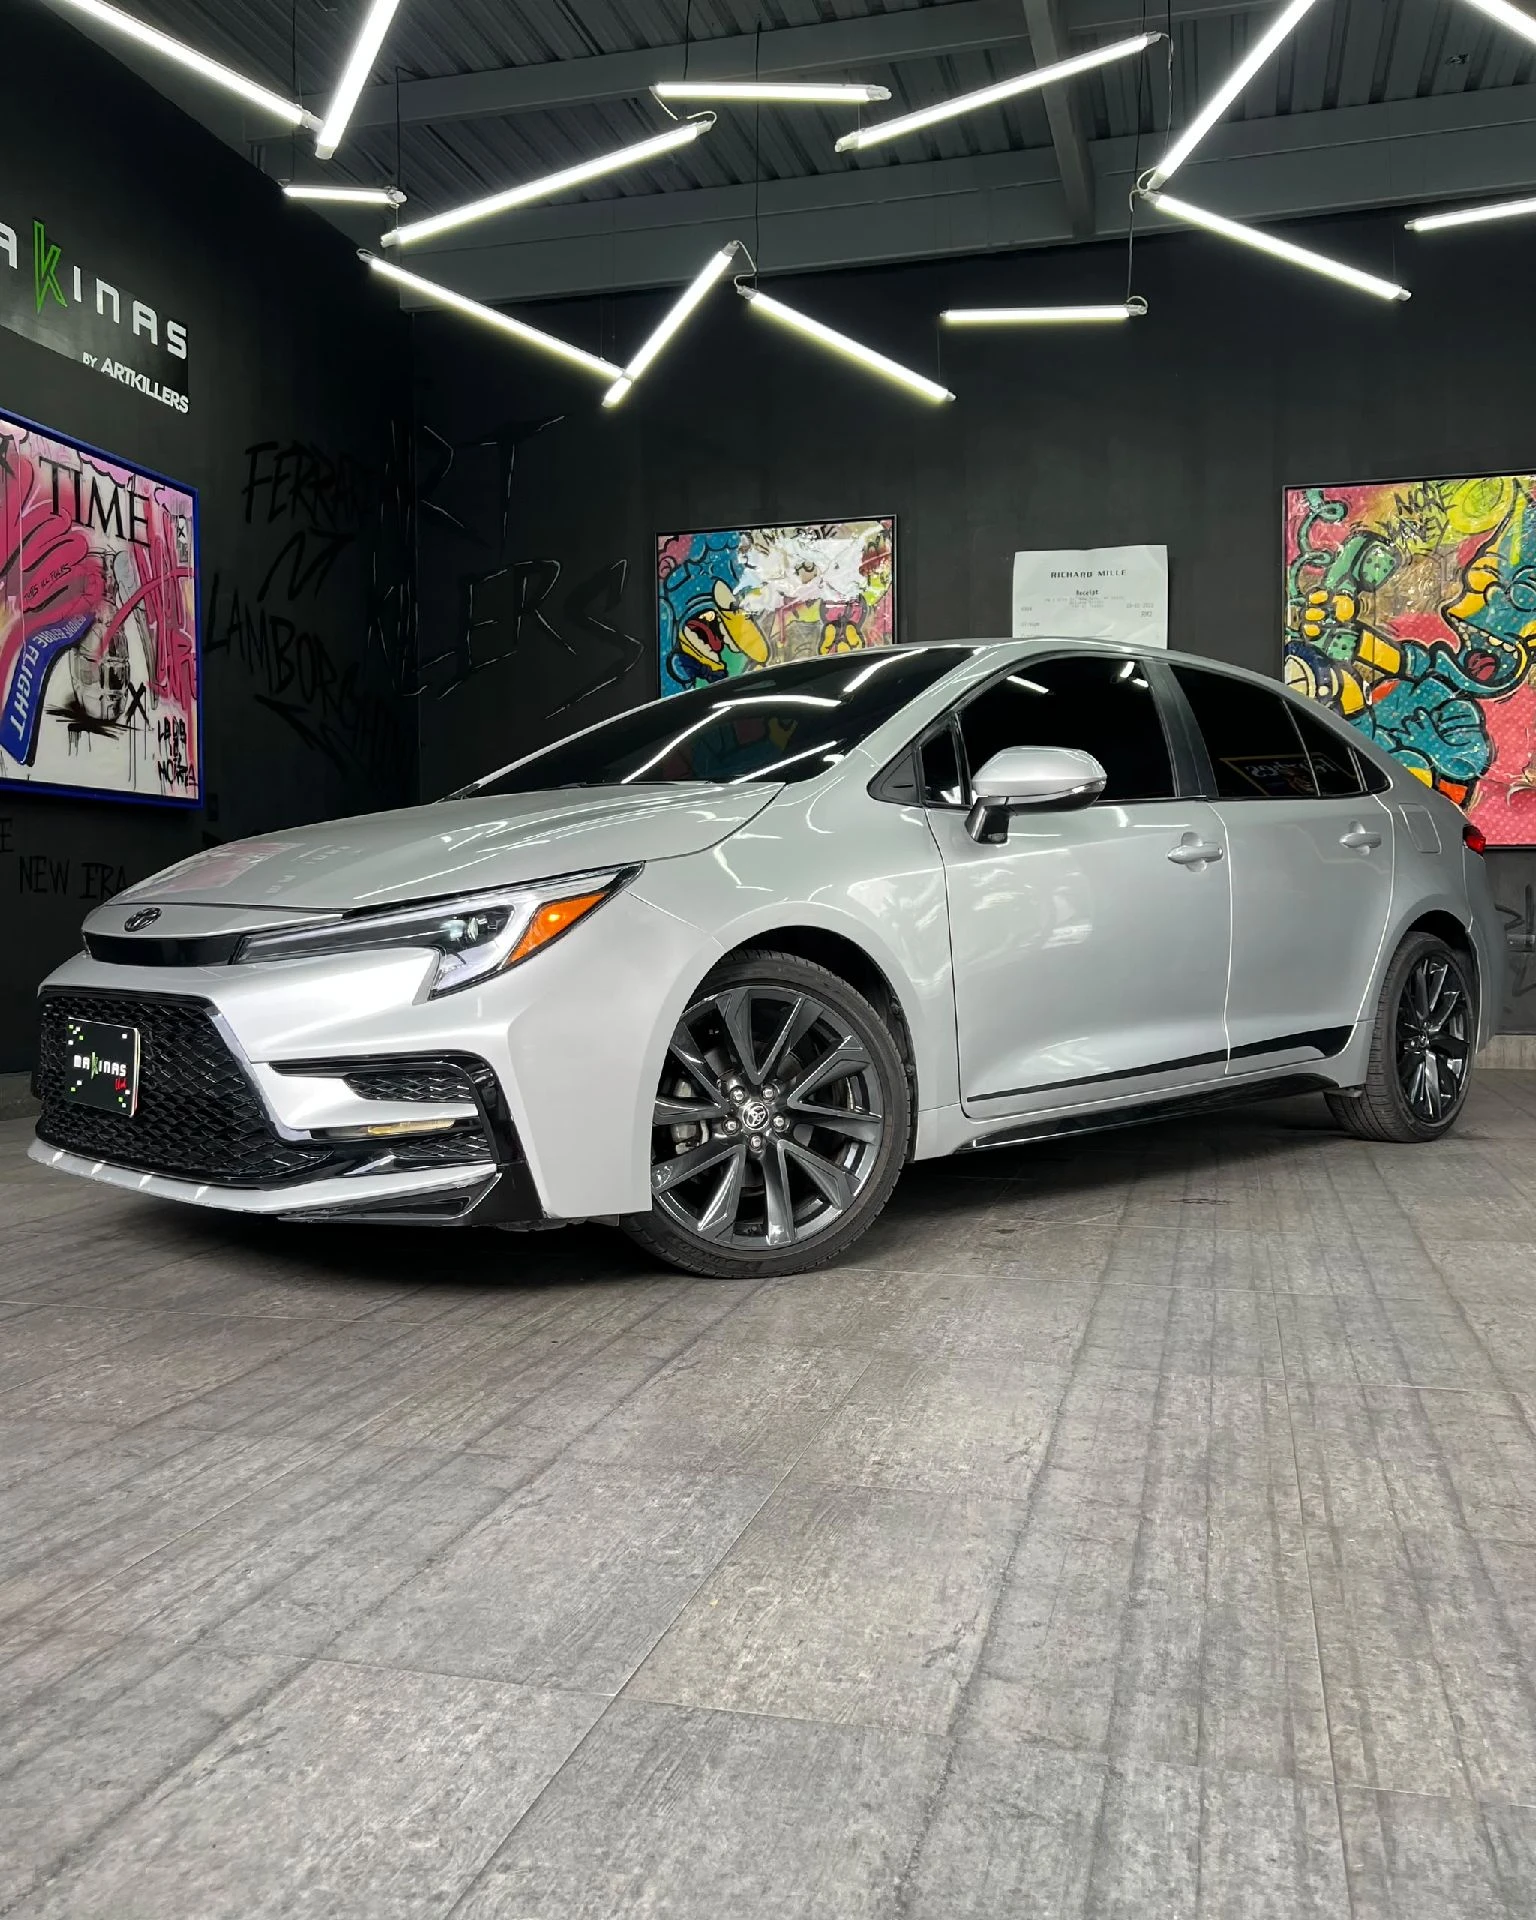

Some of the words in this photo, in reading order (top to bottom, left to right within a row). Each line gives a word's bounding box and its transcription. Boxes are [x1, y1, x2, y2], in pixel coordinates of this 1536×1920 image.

[82, 351, 98, 368] BY
[100, 357, 190, 414] ARTKILLERS
[39, 456, 151, 548] TIME
[1050, 570, 1093, 579] RICHARD
[1097, 569, 1127, 577] MILLE
[10, 645, 41, 742] FLIGHT
[19, 855, 70, 895] NEW
